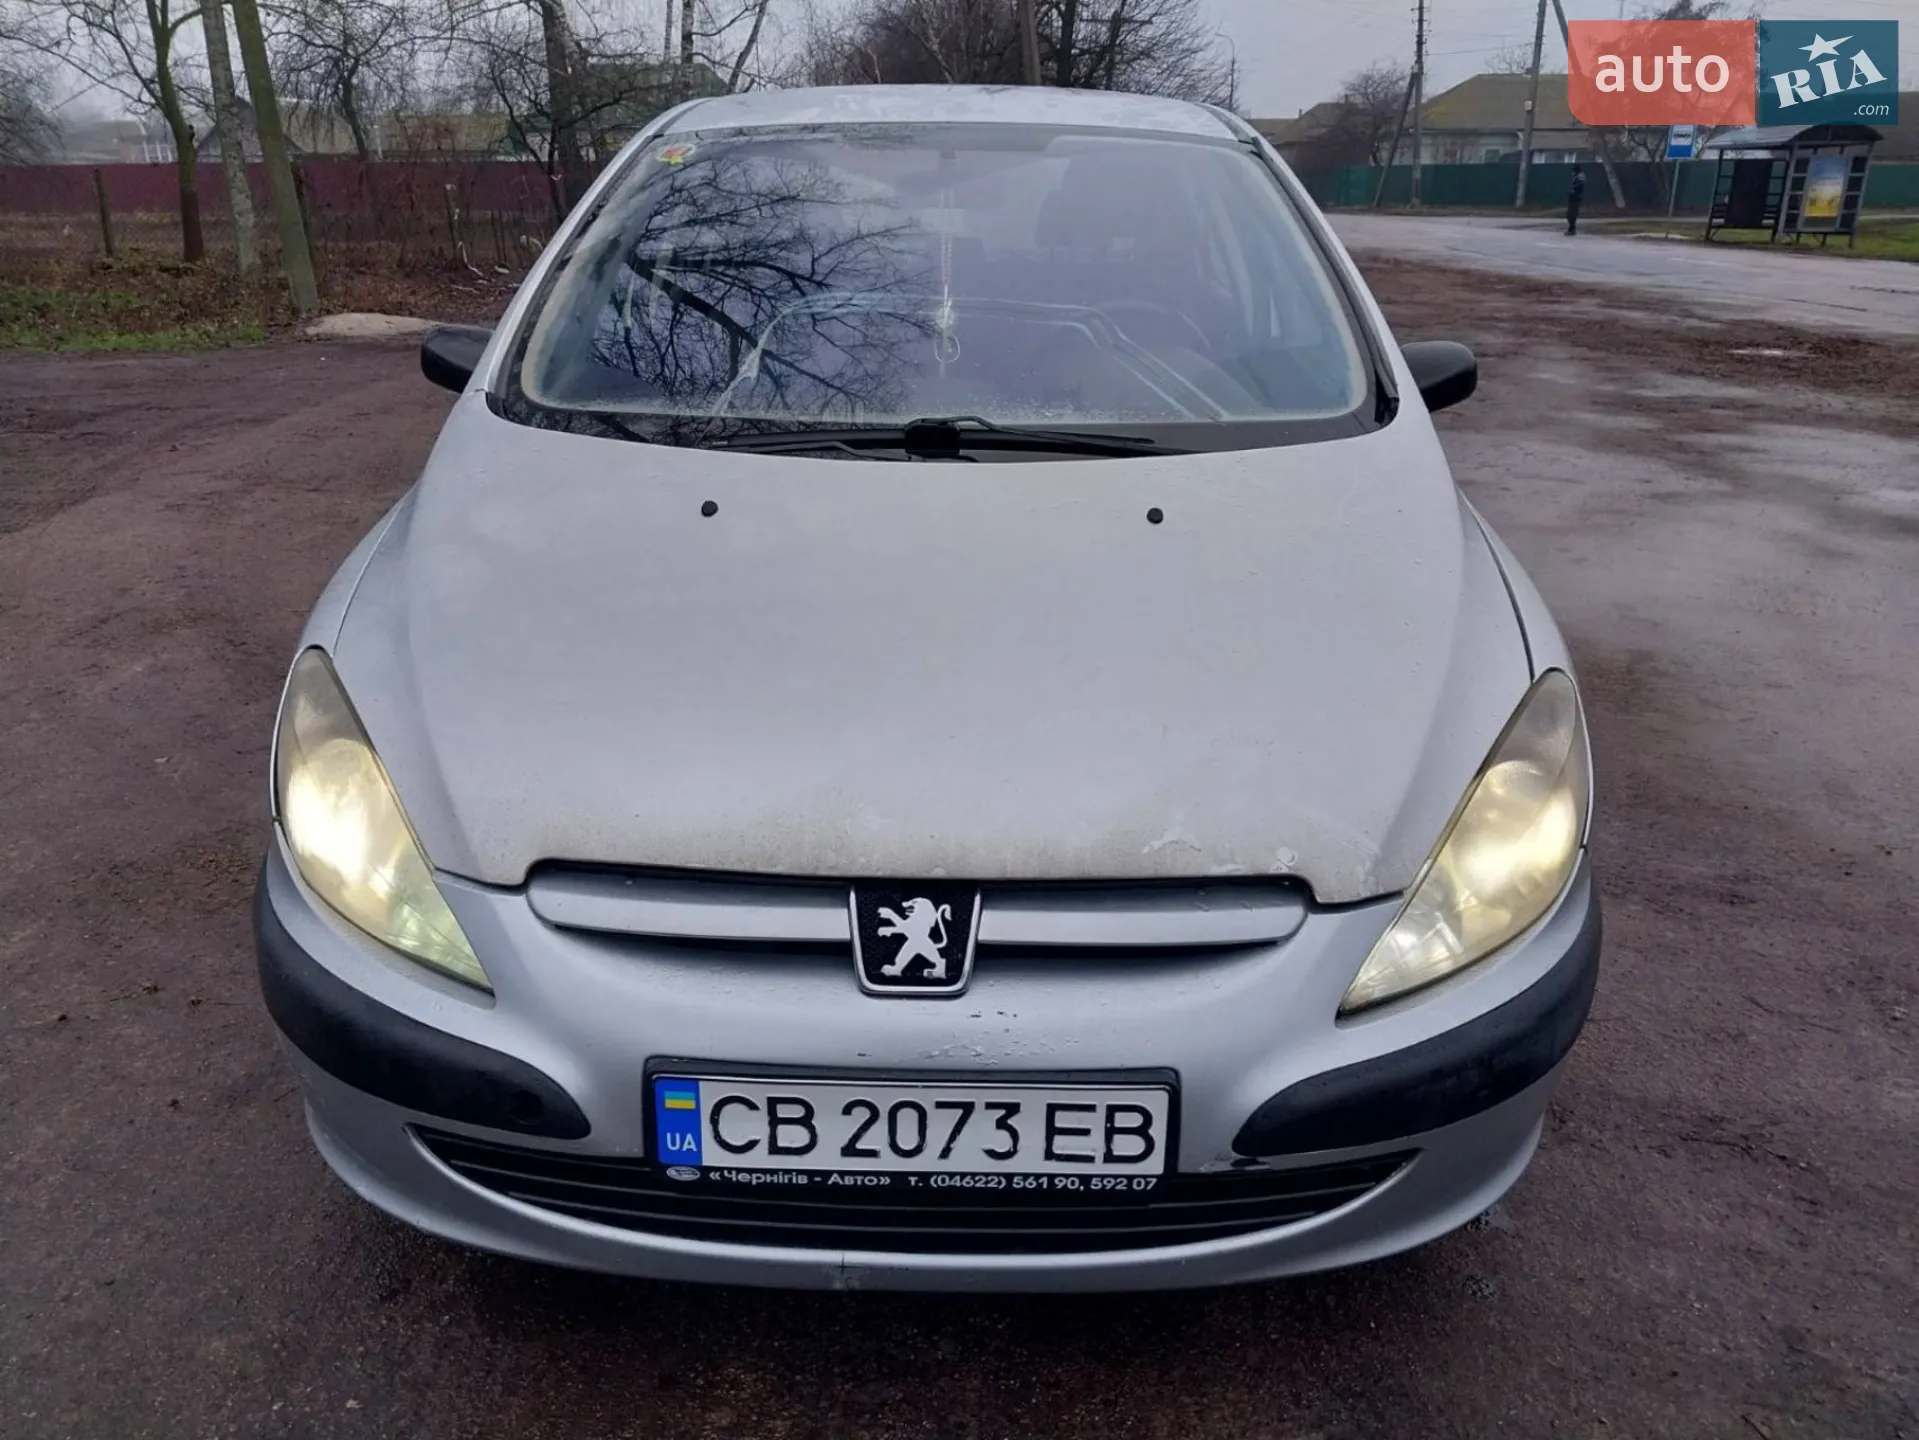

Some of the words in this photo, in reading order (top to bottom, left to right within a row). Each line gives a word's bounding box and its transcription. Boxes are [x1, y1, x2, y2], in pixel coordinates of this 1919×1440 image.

[710, 1095, 818, 1156] CB
[840, 1098, 1021, 1161] 2073
[1044, 1102, 1156, 1164] EB
[666, 1132, 697, 1152] UA
[930, 1175, 1007, 1189] (04622)
[1012, 1176, 1048, 1189] 561
[1054, 1177, 1085, 1191] 90,
[1090, 1177, 1127, 1190] 592
[1132, 1177, 1158, 1190] 07
